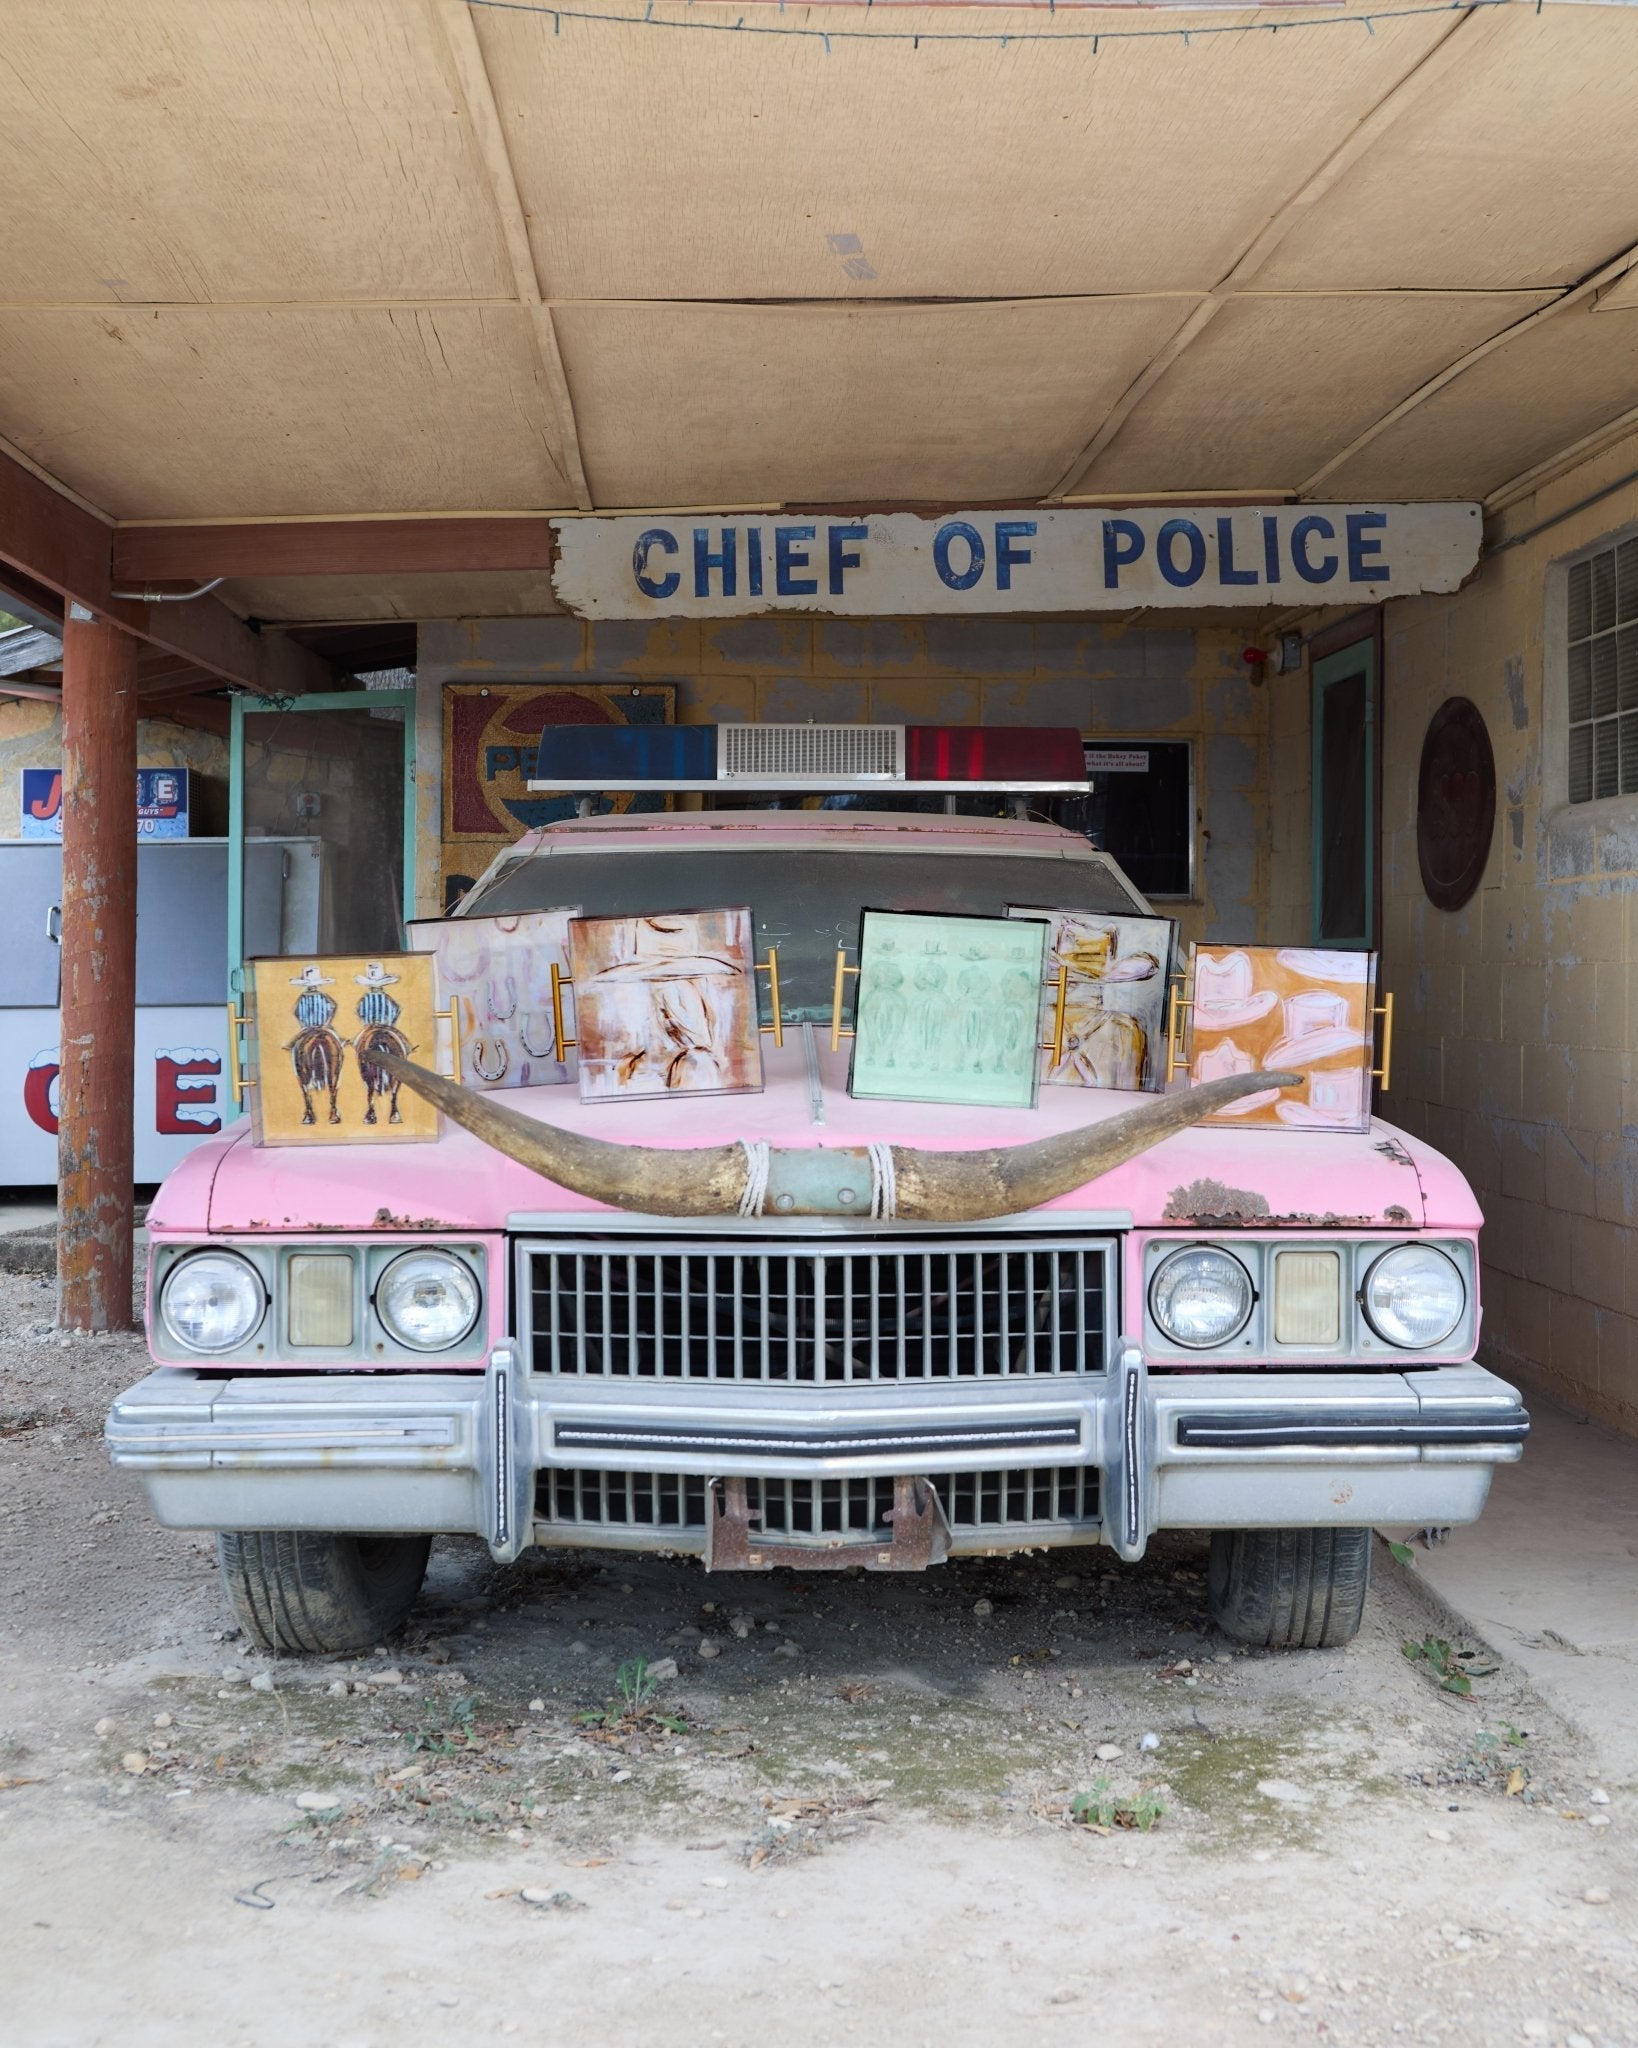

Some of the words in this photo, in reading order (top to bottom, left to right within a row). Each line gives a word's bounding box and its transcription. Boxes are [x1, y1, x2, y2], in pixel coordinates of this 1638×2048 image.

[632, 524, 869, 599] CHIEF
[932, 520, 1038, 591] OF
[1102, 512, 1391, 589] POLICE
